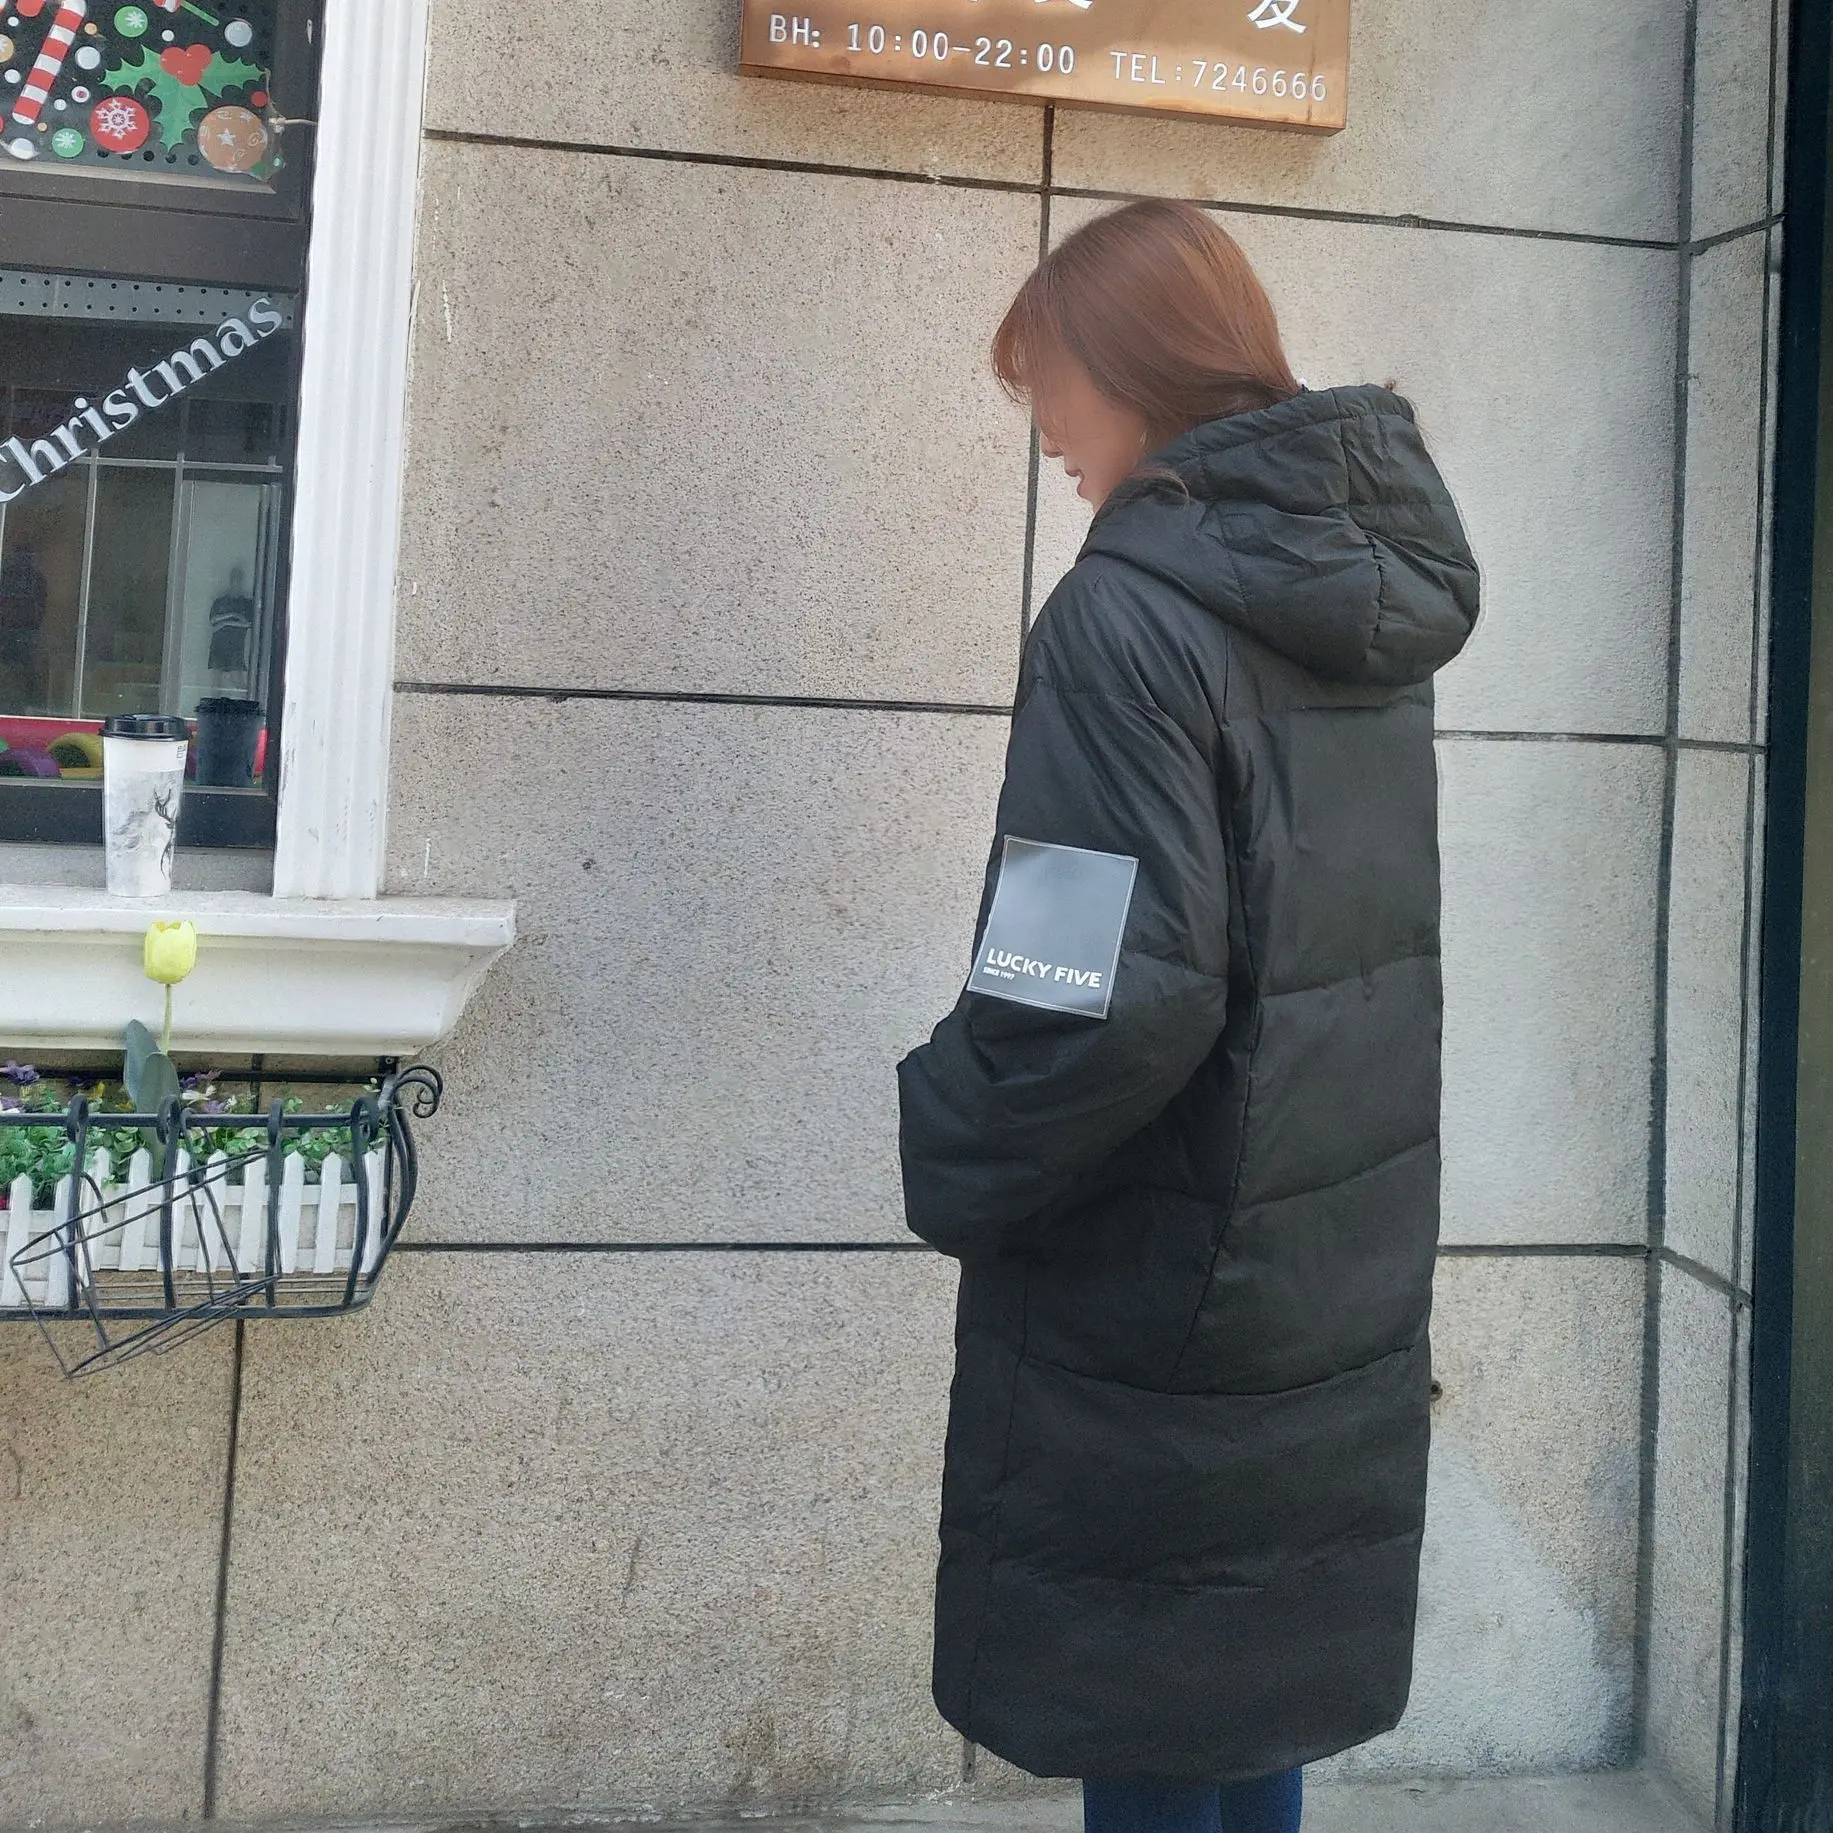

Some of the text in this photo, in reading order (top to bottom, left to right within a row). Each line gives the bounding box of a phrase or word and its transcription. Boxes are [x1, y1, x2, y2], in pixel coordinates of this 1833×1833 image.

[769, 14, 820, 48] BH:
[1109, 51, 1327, 100] TEL:7246666
[987, 948, 1102, 988] LUCKY FIVE
